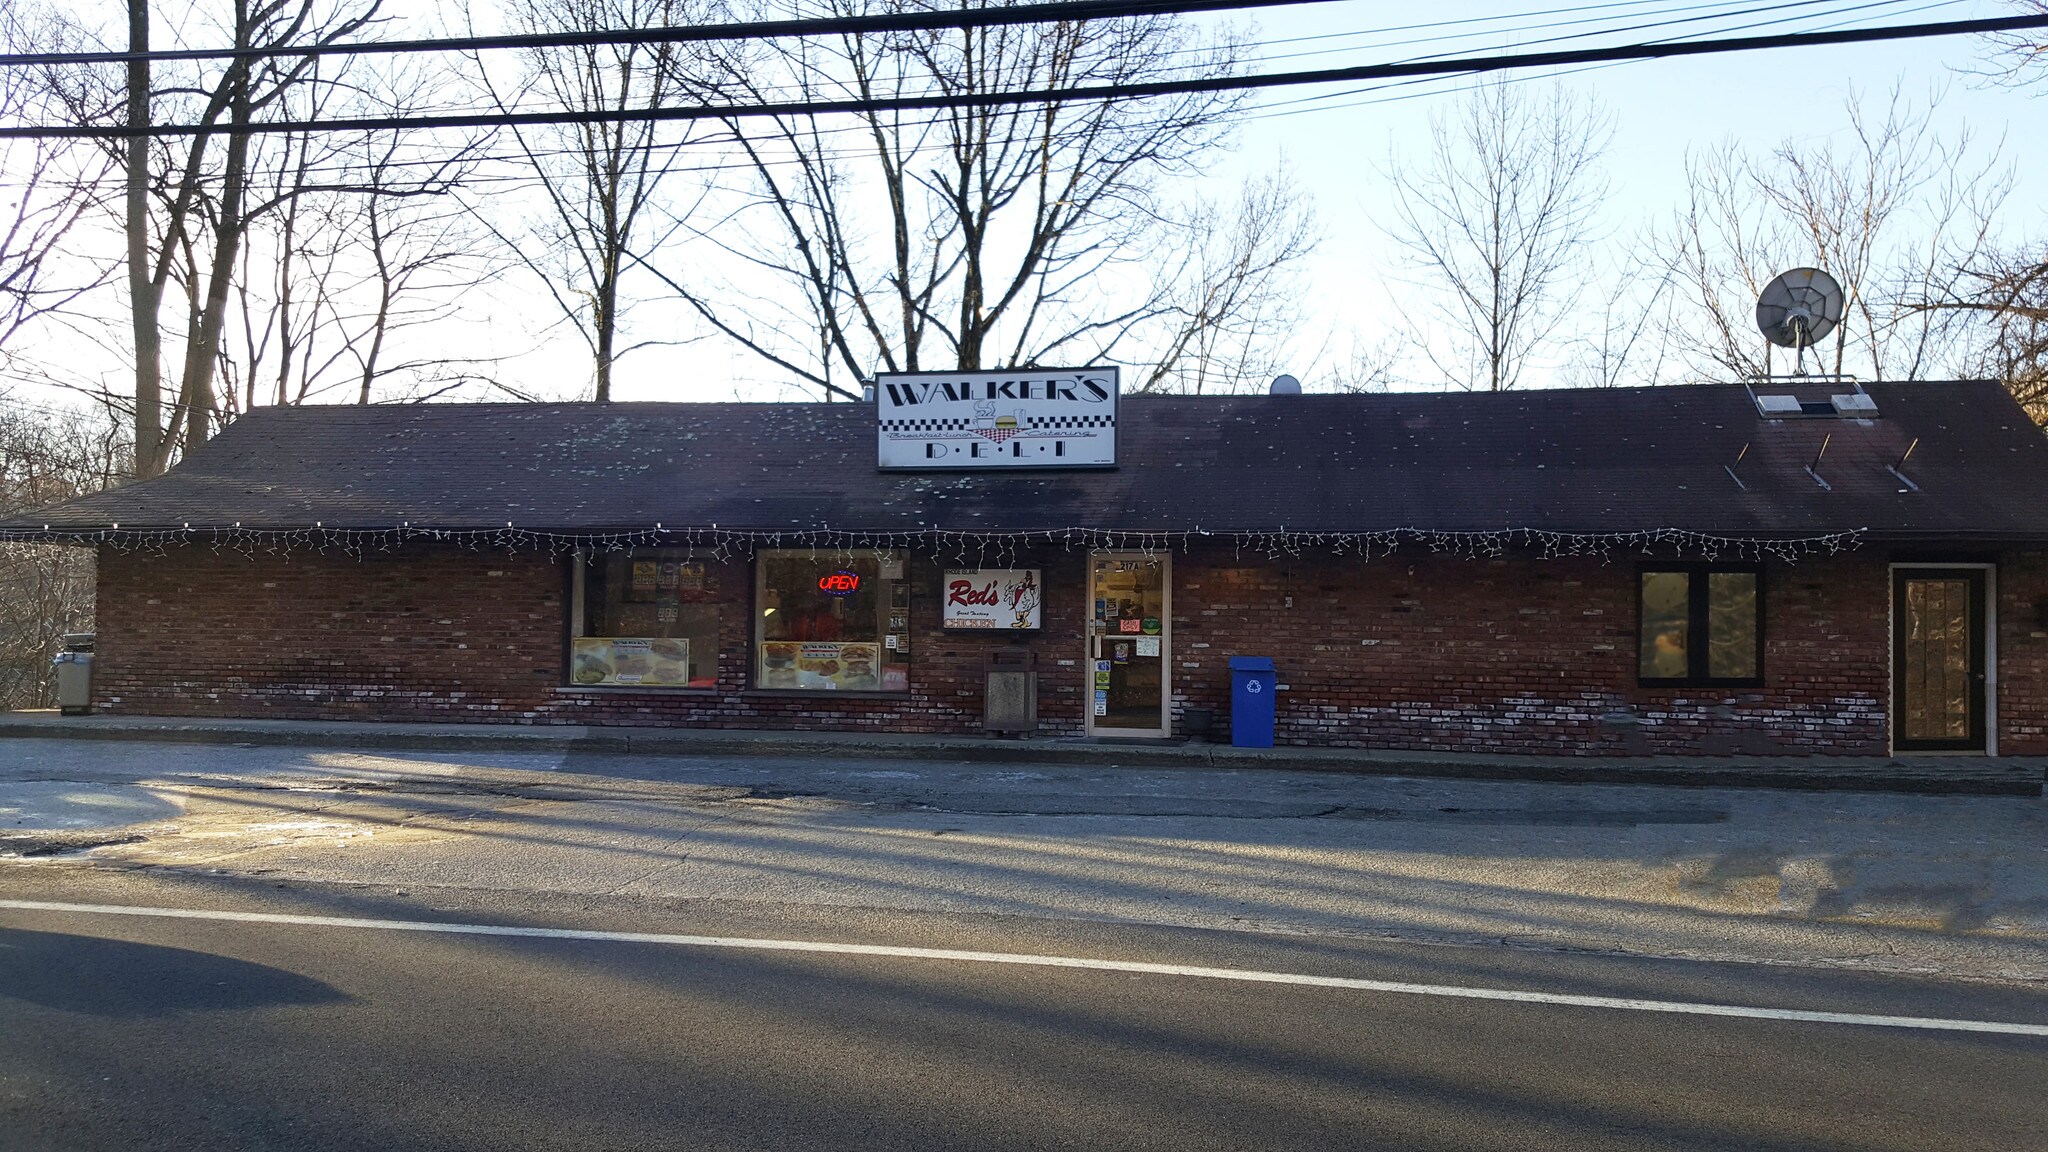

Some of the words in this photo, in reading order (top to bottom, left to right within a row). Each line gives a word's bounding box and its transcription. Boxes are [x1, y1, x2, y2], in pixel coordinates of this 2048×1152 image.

[886, 375, 1109, 407] WALKER'S
[1027, 430, 1091, 438] Catering
[819, 575, 860, 590] OPEN
[948, 579, 999, 607] Red's
[944, 618, 997, 628] CHICKEN
